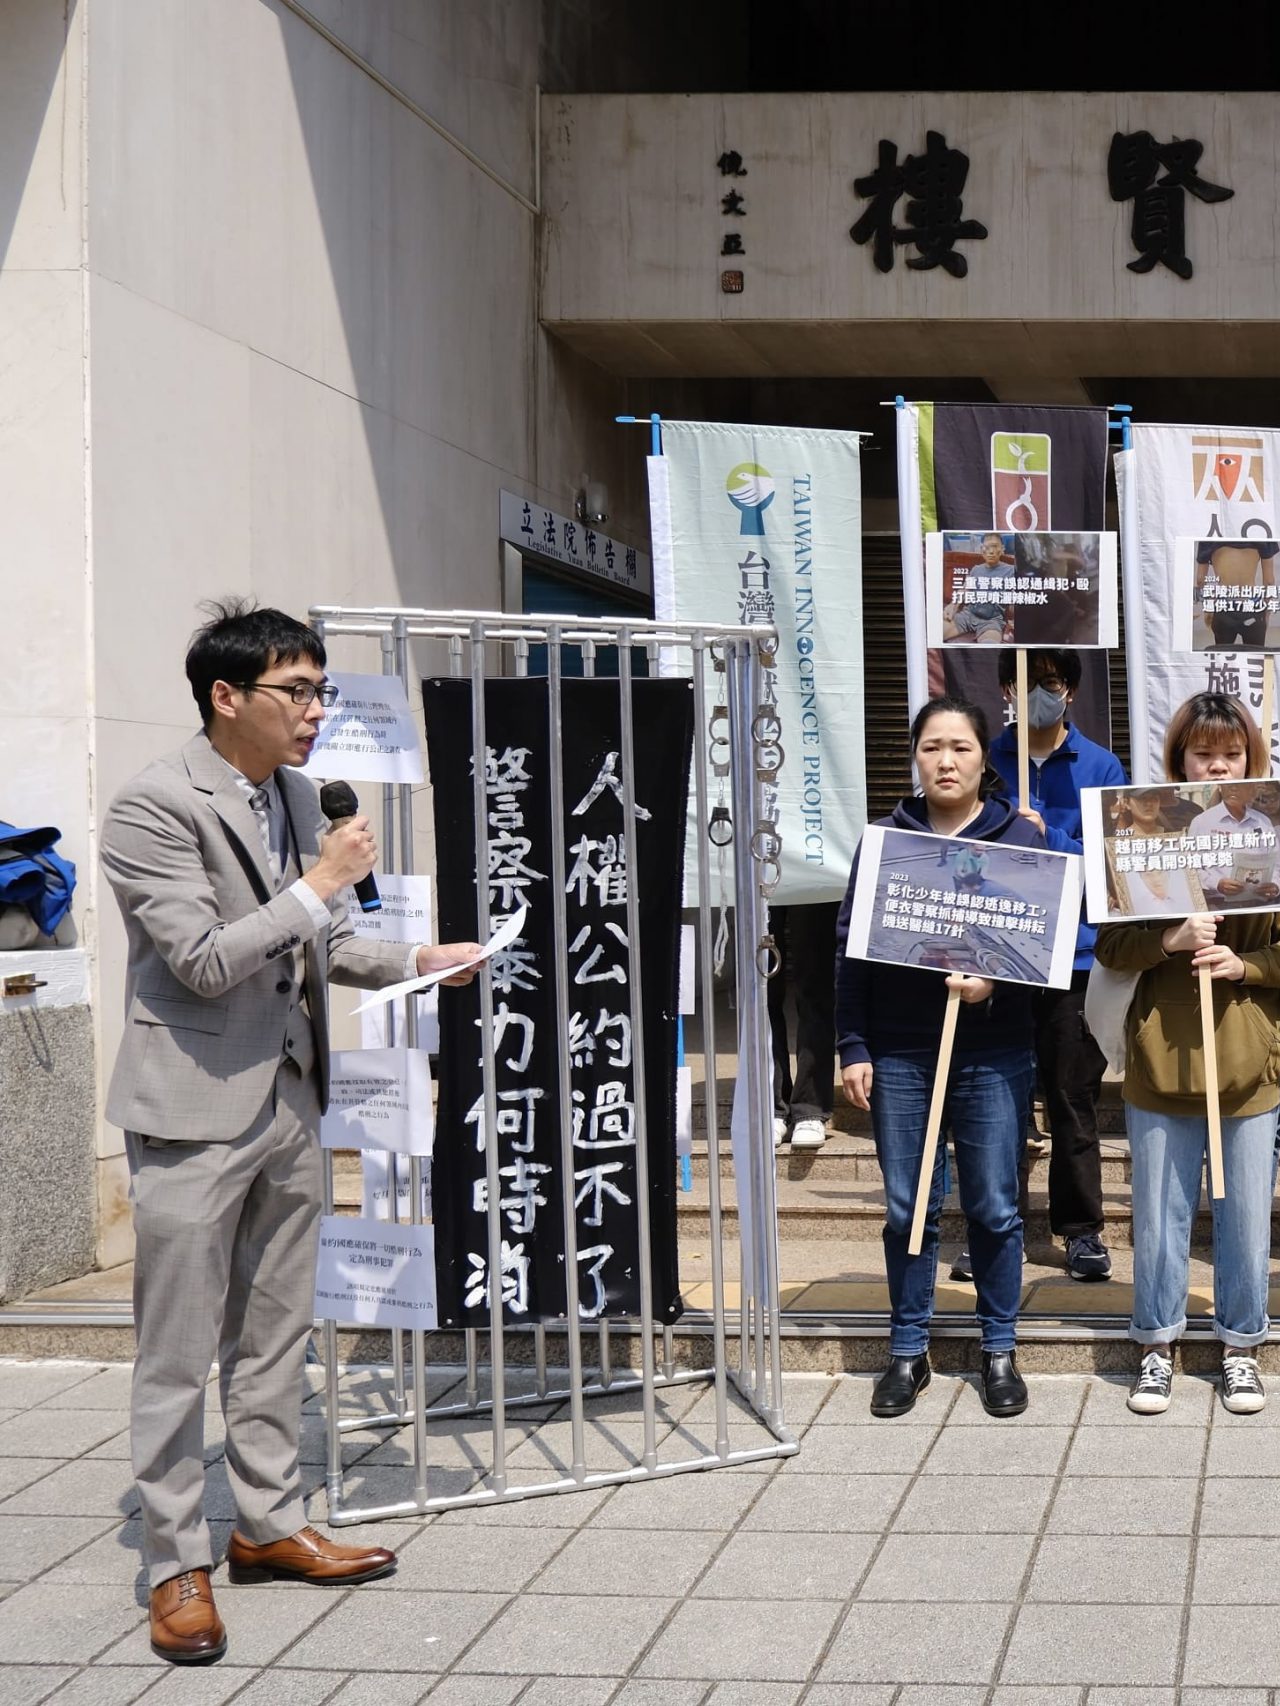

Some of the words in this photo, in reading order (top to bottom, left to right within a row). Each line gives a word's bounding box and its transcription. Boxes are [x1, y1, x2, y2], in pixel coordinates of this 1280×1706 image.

[793, 473, 812, 576] TAIWAN
[528, 537, 562, 559] Legislative
[802, 755, 824, 866] PROJECT
[1115, 829, 1135, 837] 2017
[1115, 832, 1276, 855] 越南移工阮國非遭新竹
[890, 872, 909, 882] 2023
